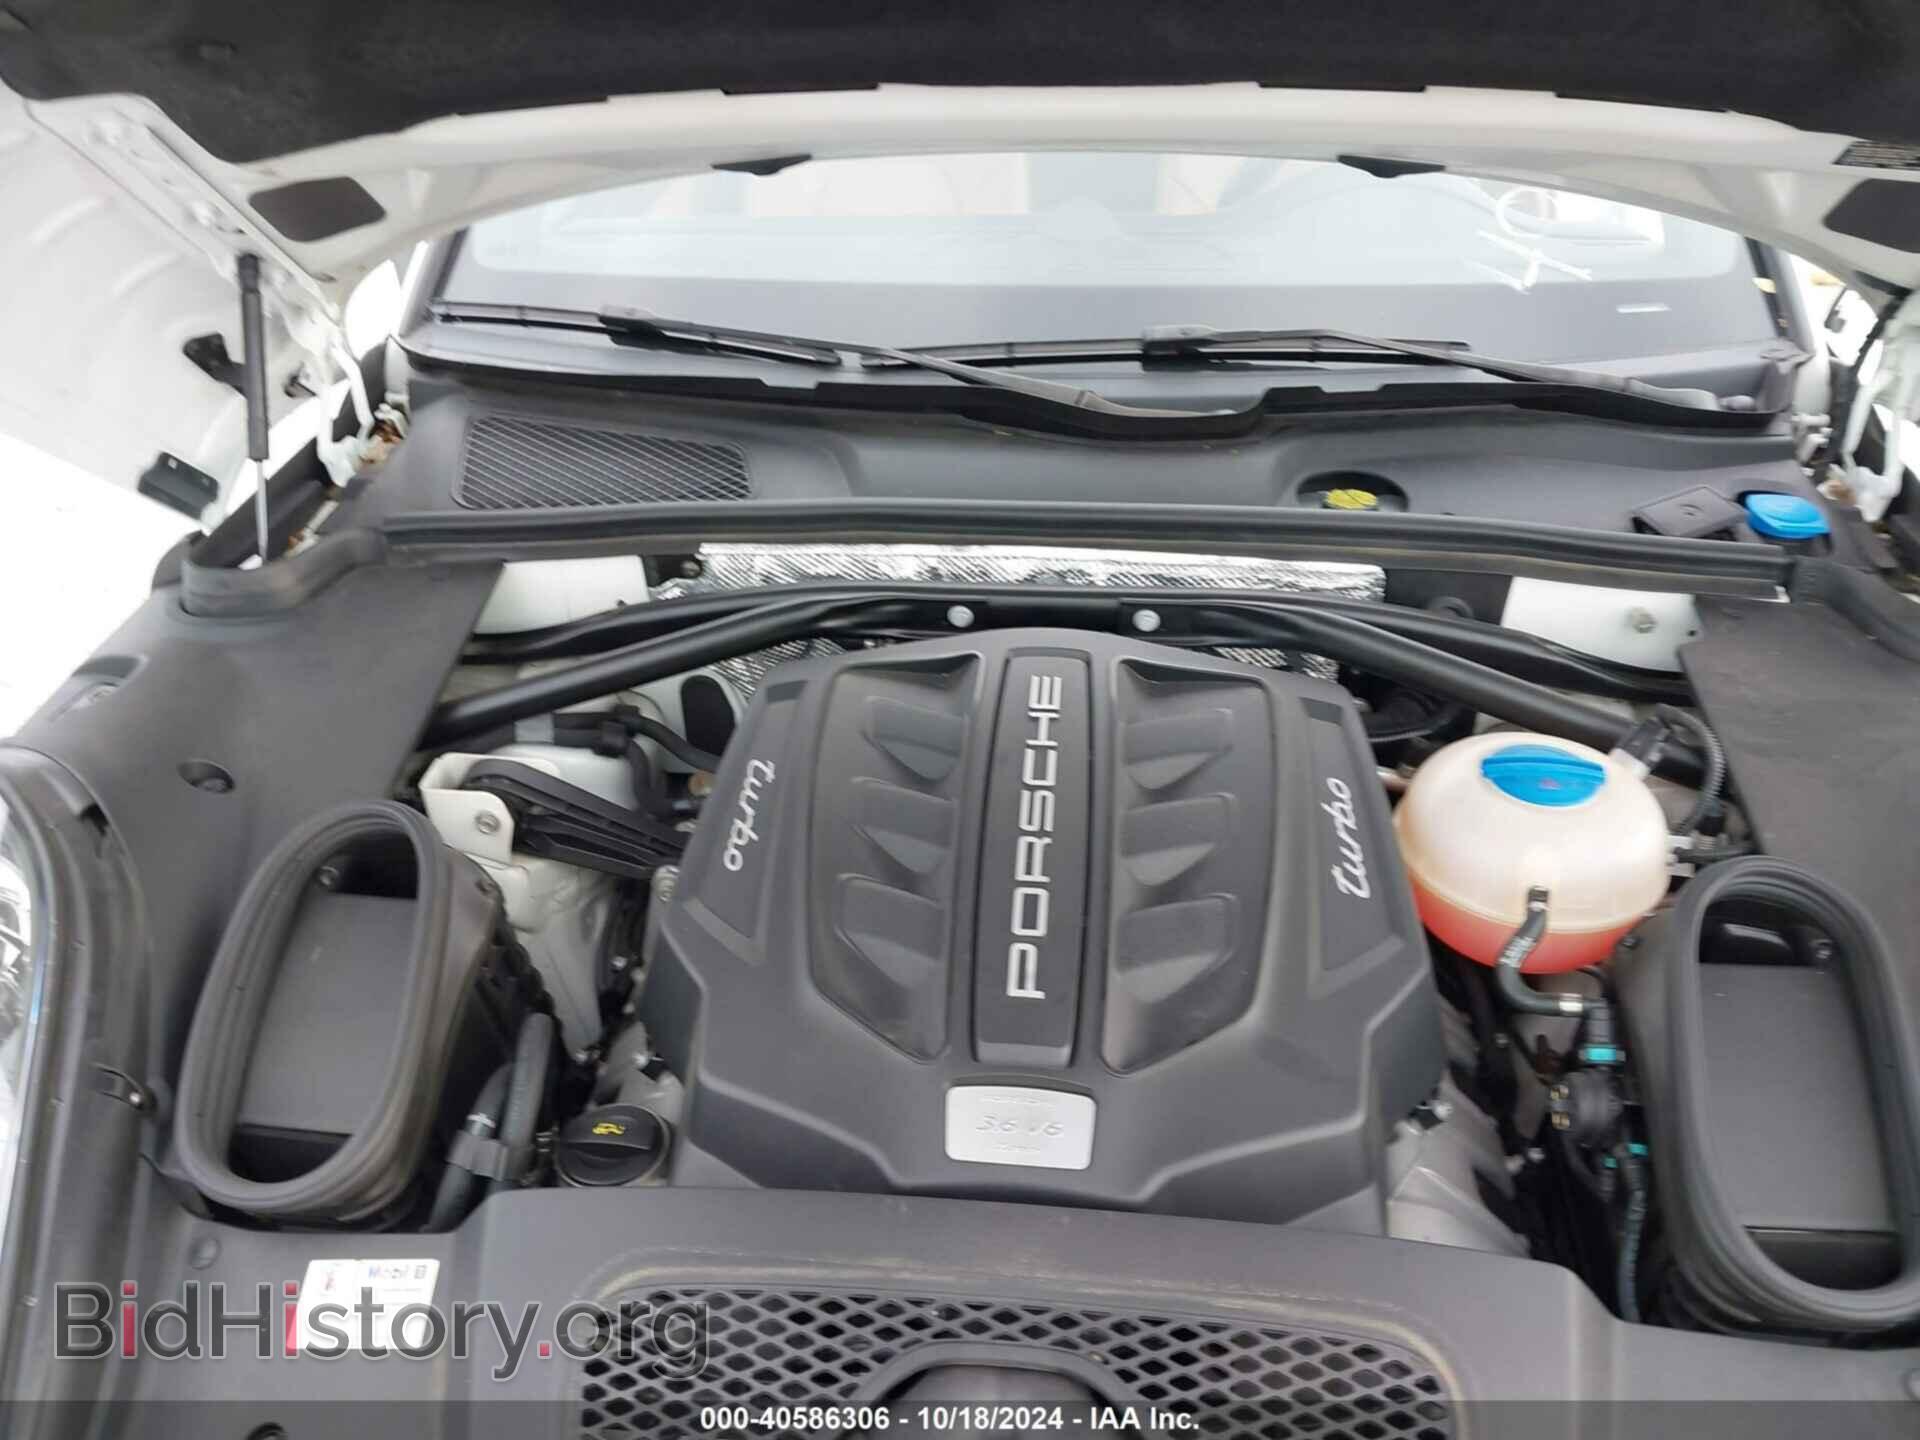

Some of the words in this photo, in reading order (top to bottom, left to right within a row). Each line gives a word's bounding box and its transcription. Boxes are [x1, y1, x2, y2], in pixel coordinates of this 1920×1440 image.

[723, 759, 776, 872] turbo
[1006, 675, 1063, 1000] PORSCHE
[1320, 777, 1371, 899] turbo
